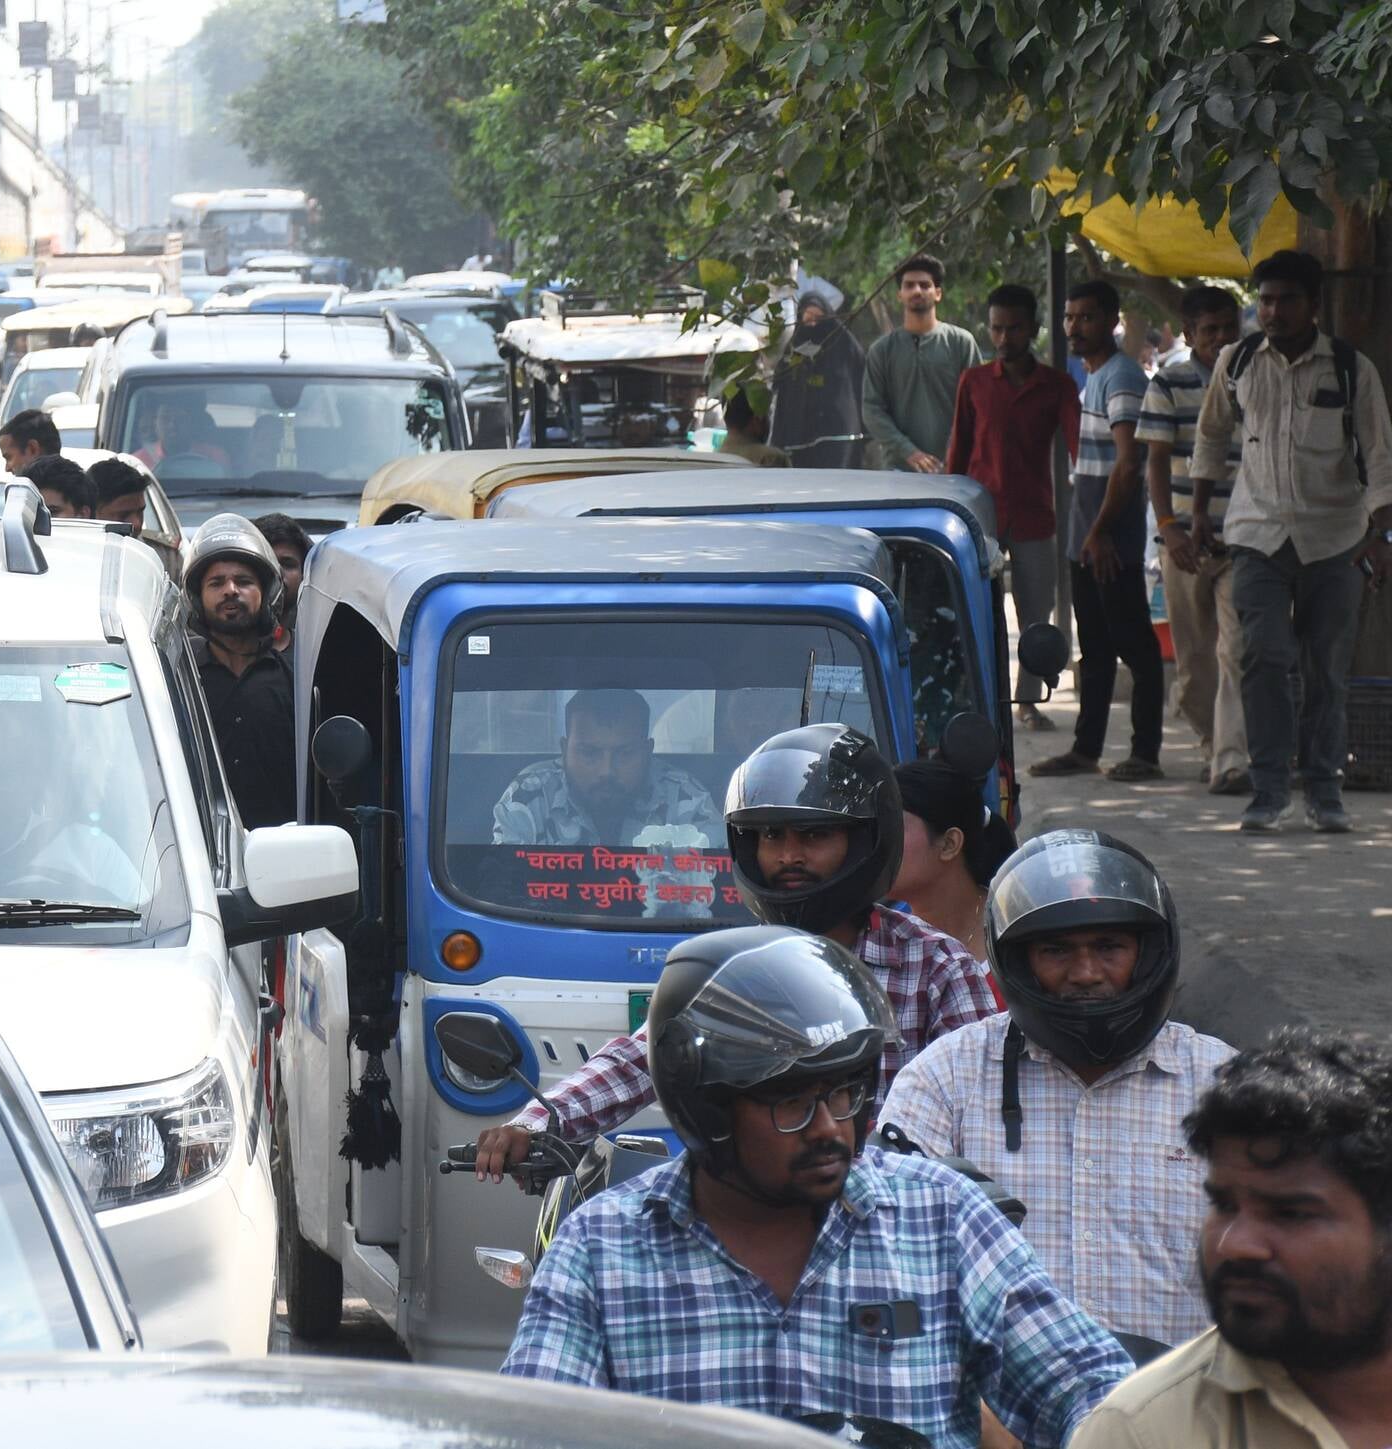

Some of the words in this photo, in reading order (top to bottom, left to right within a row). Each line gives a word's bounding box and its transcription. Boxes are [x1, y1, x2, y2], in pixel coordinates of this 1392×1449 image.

[592, 847, 666, 872] विमान
[526, 882, 569, 900] जय
[577, 877, 648, 908] रघुवीर
[657, 885, 714, 904] कहत
